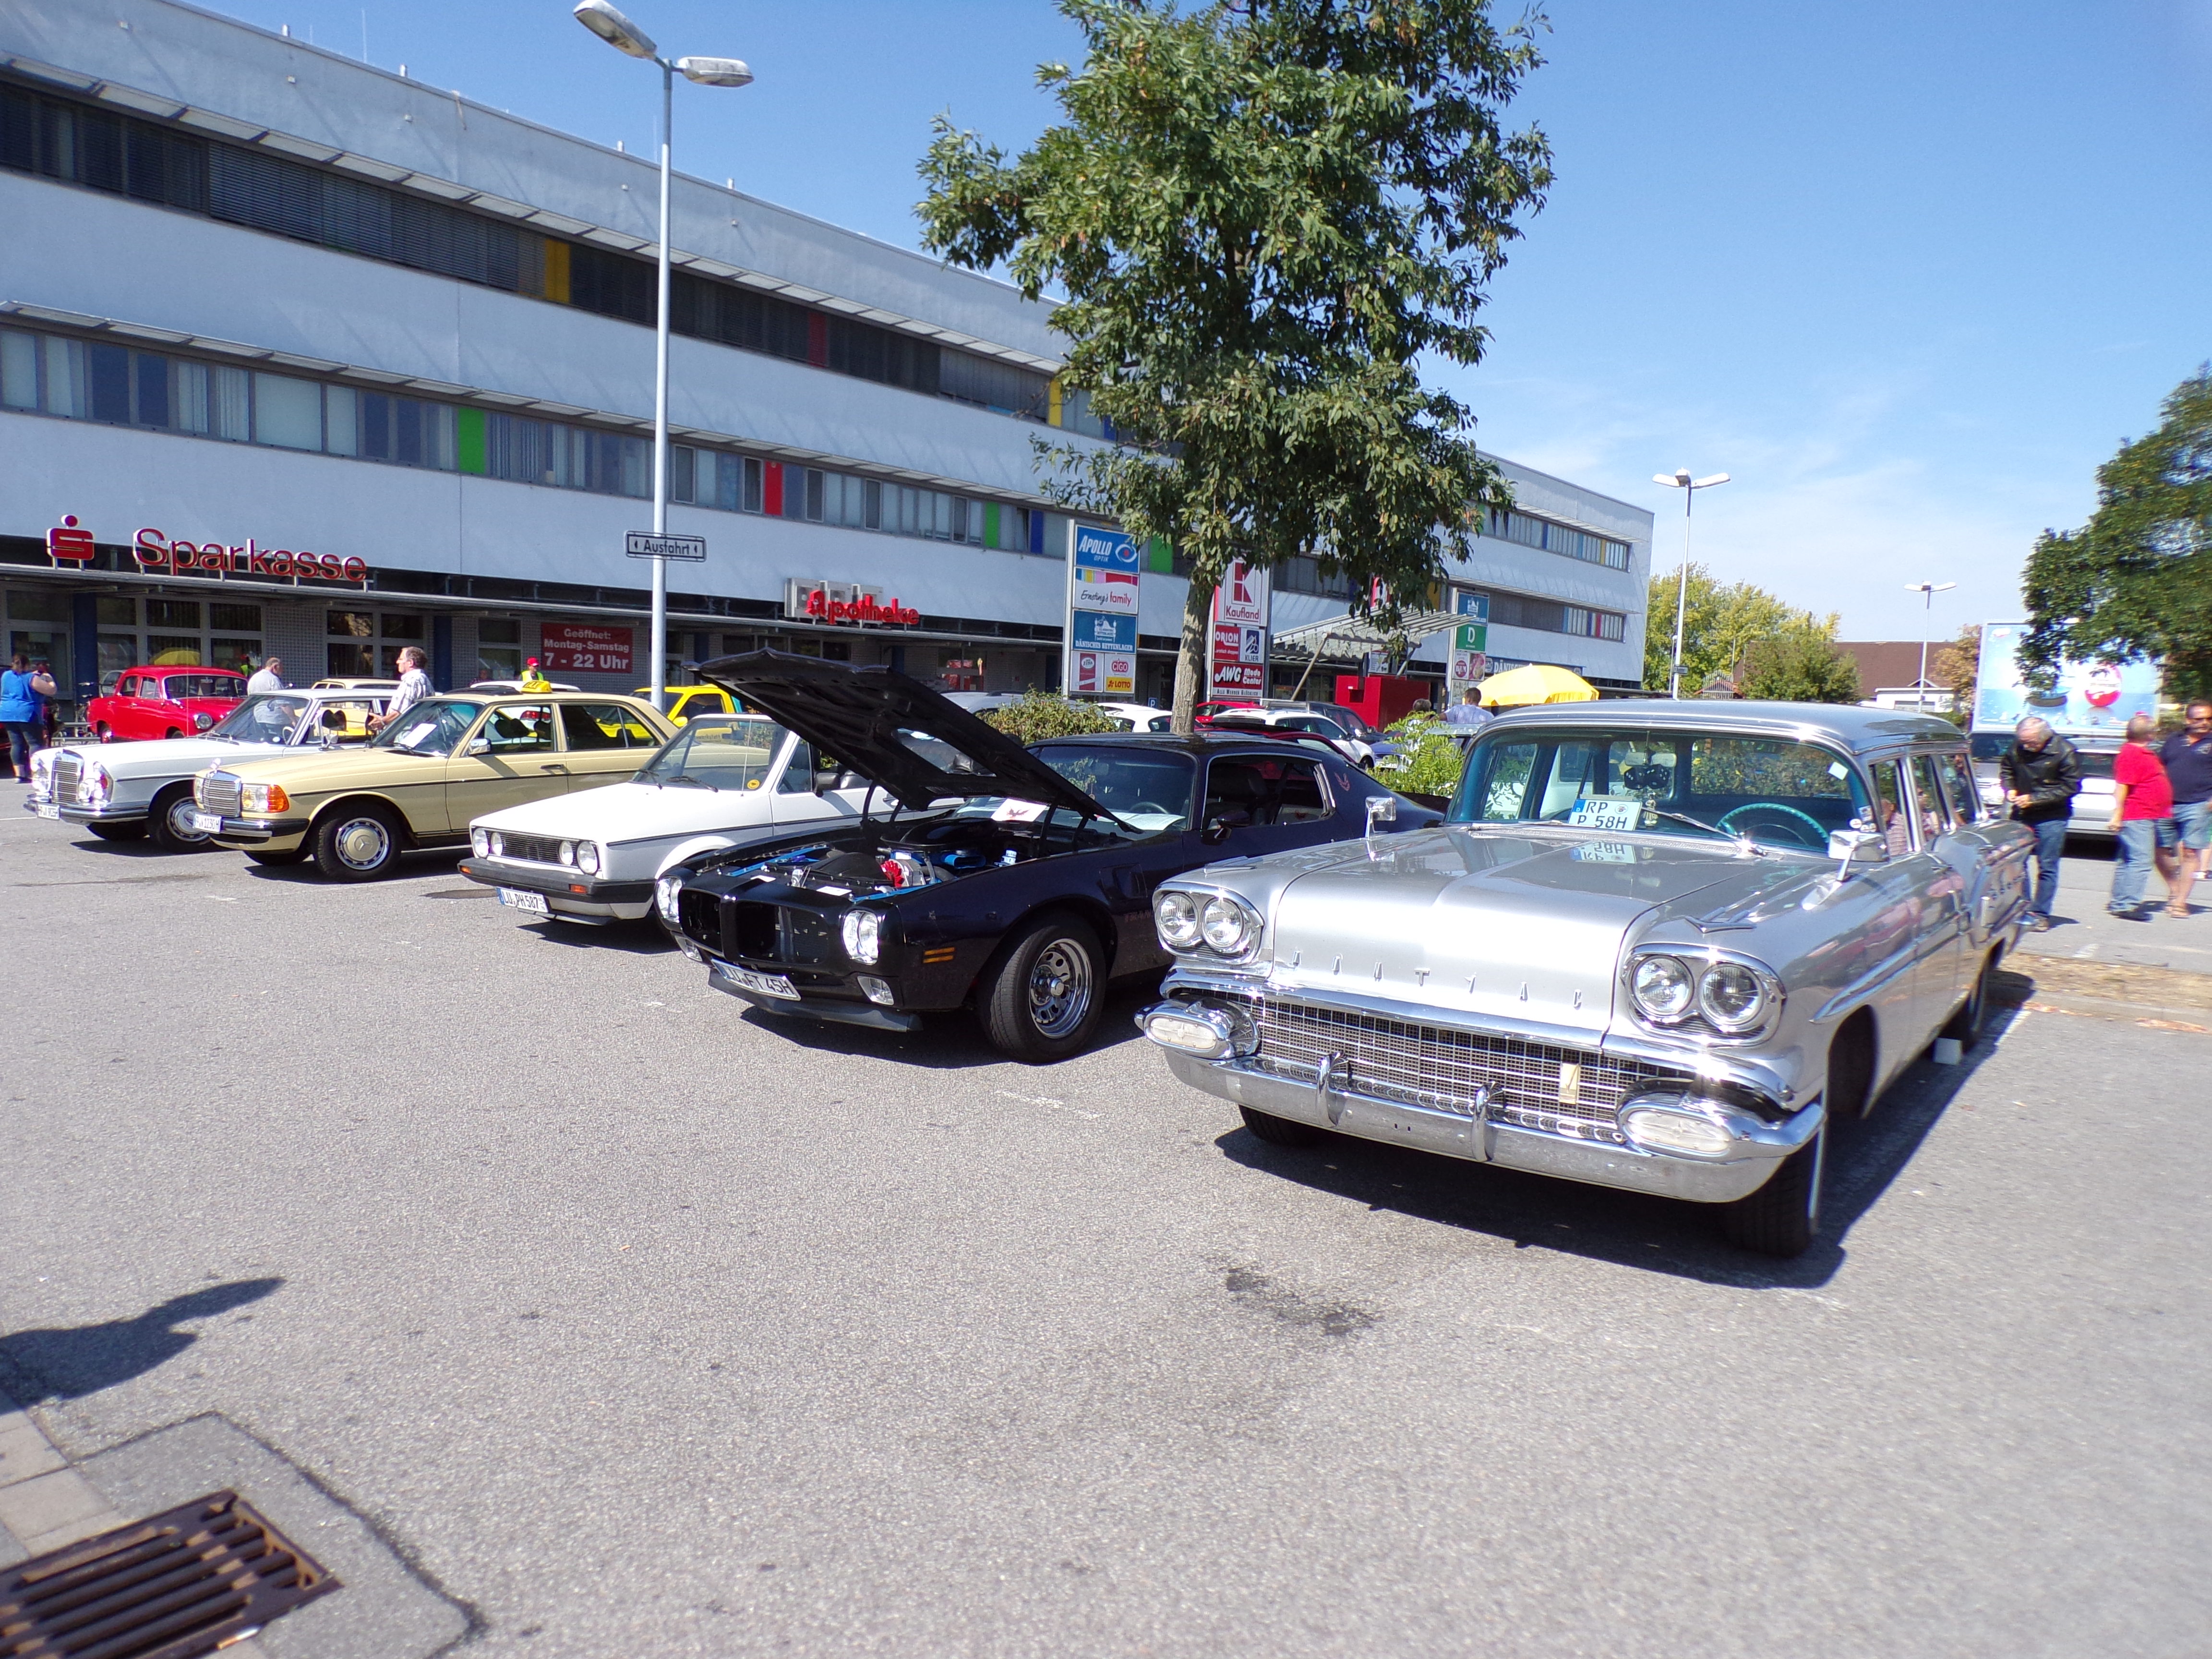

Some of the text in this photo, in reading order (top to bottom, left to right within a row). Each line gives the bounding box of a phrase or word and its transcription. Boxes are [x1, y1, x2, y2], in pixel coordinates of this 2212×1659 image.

[643, 539, 690, 555] Ausfahrt
[1078, 535, 1113, 556] APOLLO
[133, 528, 367, 582] Sparkasse
[1081, 589, 1132, 607] Ernsting's family
[805, 589, 920, 625] Apotheke
[1226, 605, 1260, 620] Kaufland
[564, 628, 611, 640] Geöffnet:
[1215, 631, 1239, 646] ORION
[543, 638, 629, 653] Montag-Samstag
[1101, 642, 1133, 651] BETTENLAGER
[544, 652, 554, 666] 7
[573, 653, 595, 668] 22
[600, 654, 629, 669] Uhr
[1214, 666, 1242, 683] AWG
[1242, 676, 1262, 685] Center
[1586, 801, 1608, 814] RP
[1577, 815, 1628, 829] P 58H
[501, 891, 513, 904] LU
[514, 893, 527, 907] PH
[524, 895, 539, 910] 587
[765, 977, 795, 995] 45H
